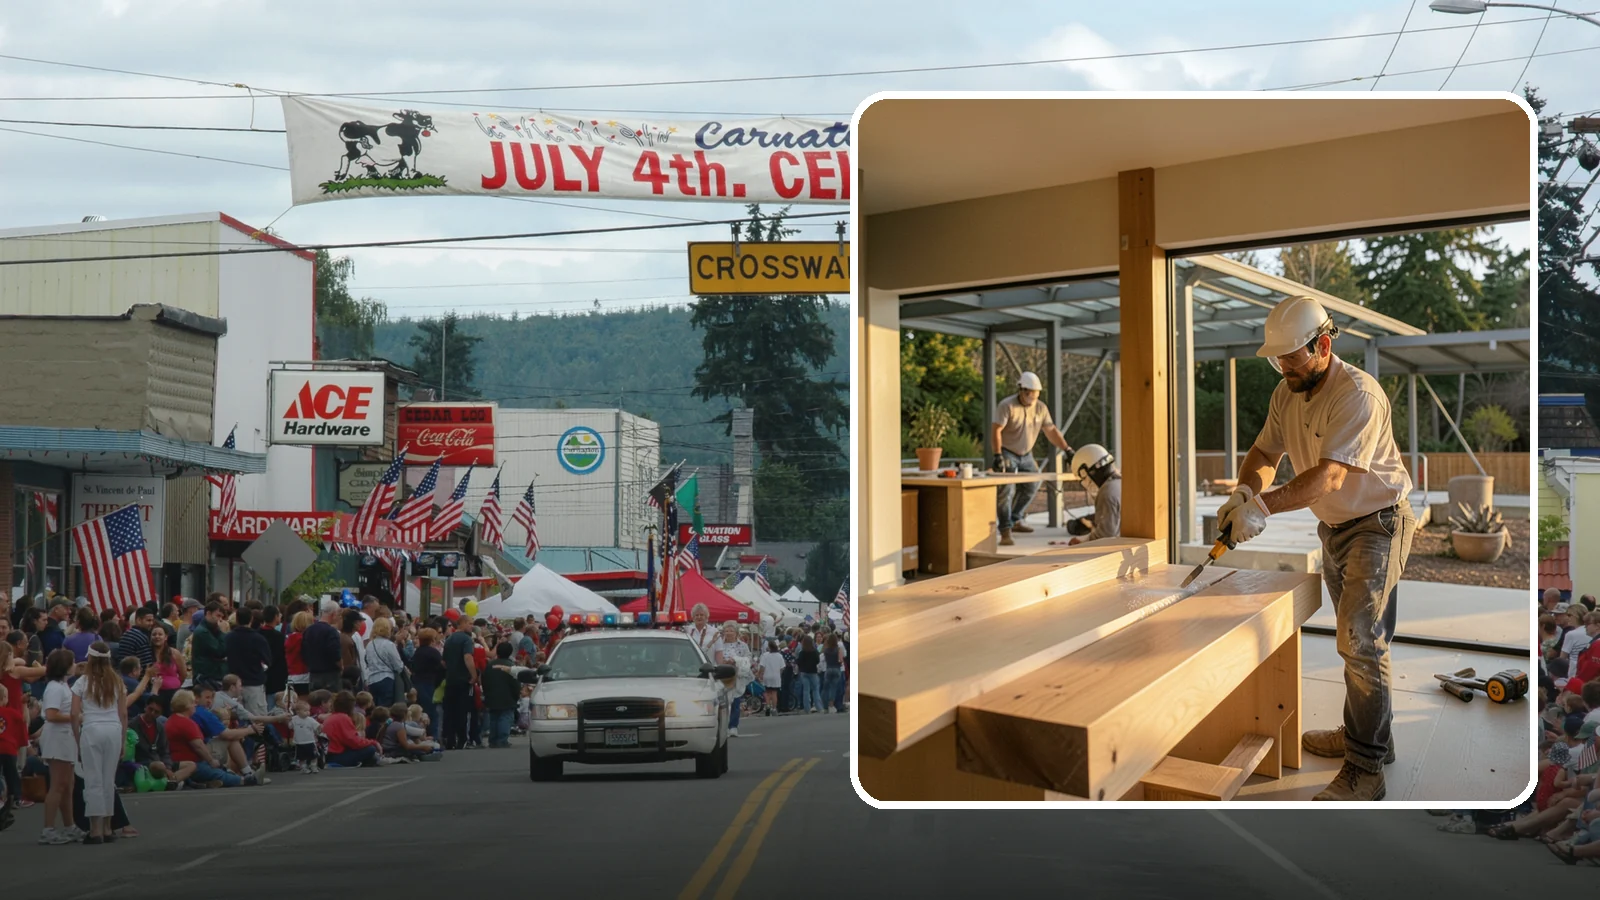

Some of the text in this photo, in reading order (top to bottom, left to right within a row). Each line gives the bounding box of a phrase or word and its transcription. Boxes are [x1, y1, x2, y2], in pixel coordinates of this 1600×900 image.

[481, 141, 605, 193] JULY
[632, 150, 747, 198] 4th.
[697, 254, 850, 280] CROSSWA
[282, 380, 374, 420] ACE
[405, 409, 453, 423] CEDAR
[283, 421, 371, 437] Hardware
[416, 428, 477, 447] Coca-Cola
[83, 485, 155, 496] St. Vincent de Paul
[688, 526, 742, 536] CRNATION
[699, 535, 731, 544] GLASS
